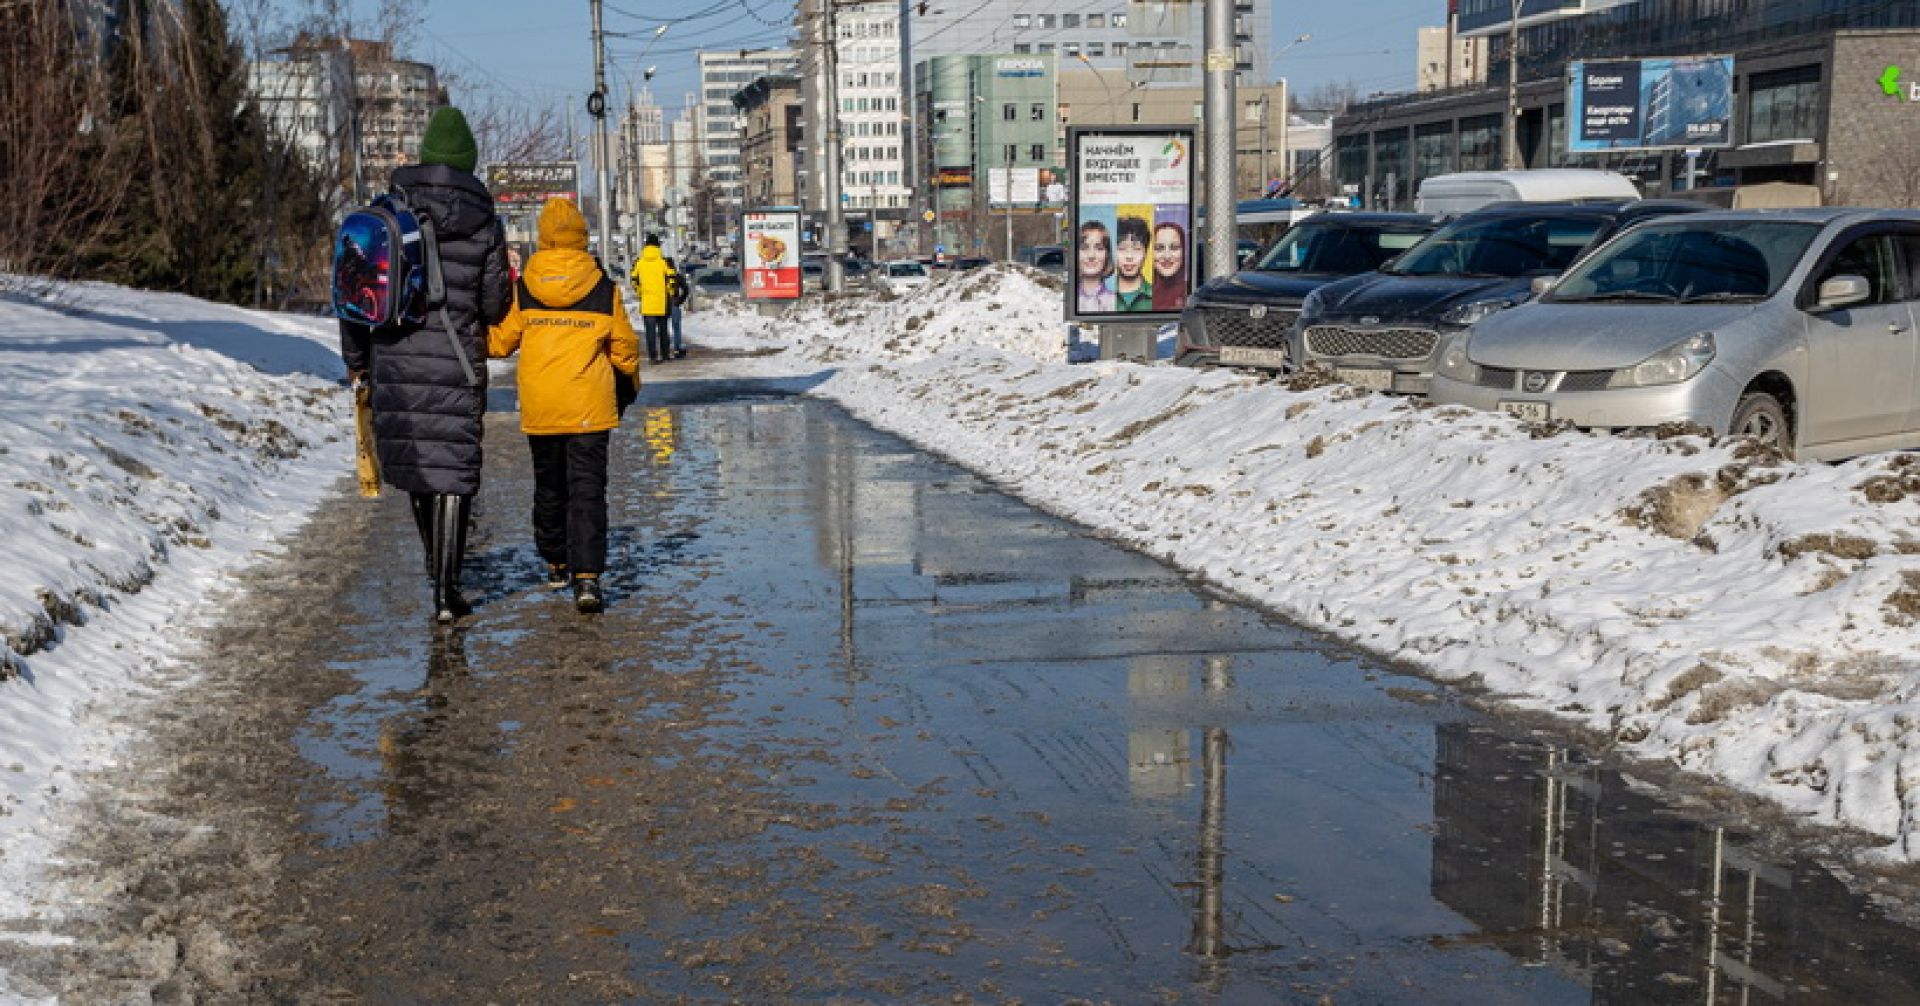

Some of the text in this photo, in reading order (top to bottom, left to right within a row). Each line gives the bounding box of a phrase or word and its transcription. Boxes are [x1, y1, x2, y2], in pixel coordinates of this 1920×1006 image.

[1085, 158, 1141, 169] БУДУЩЕЕ
[1085, 172, 1136, 183] ВМЕСТЕ!
[550, 317, 572, 326] LIGHT
[573, 319, 596, 328] LIGHT
